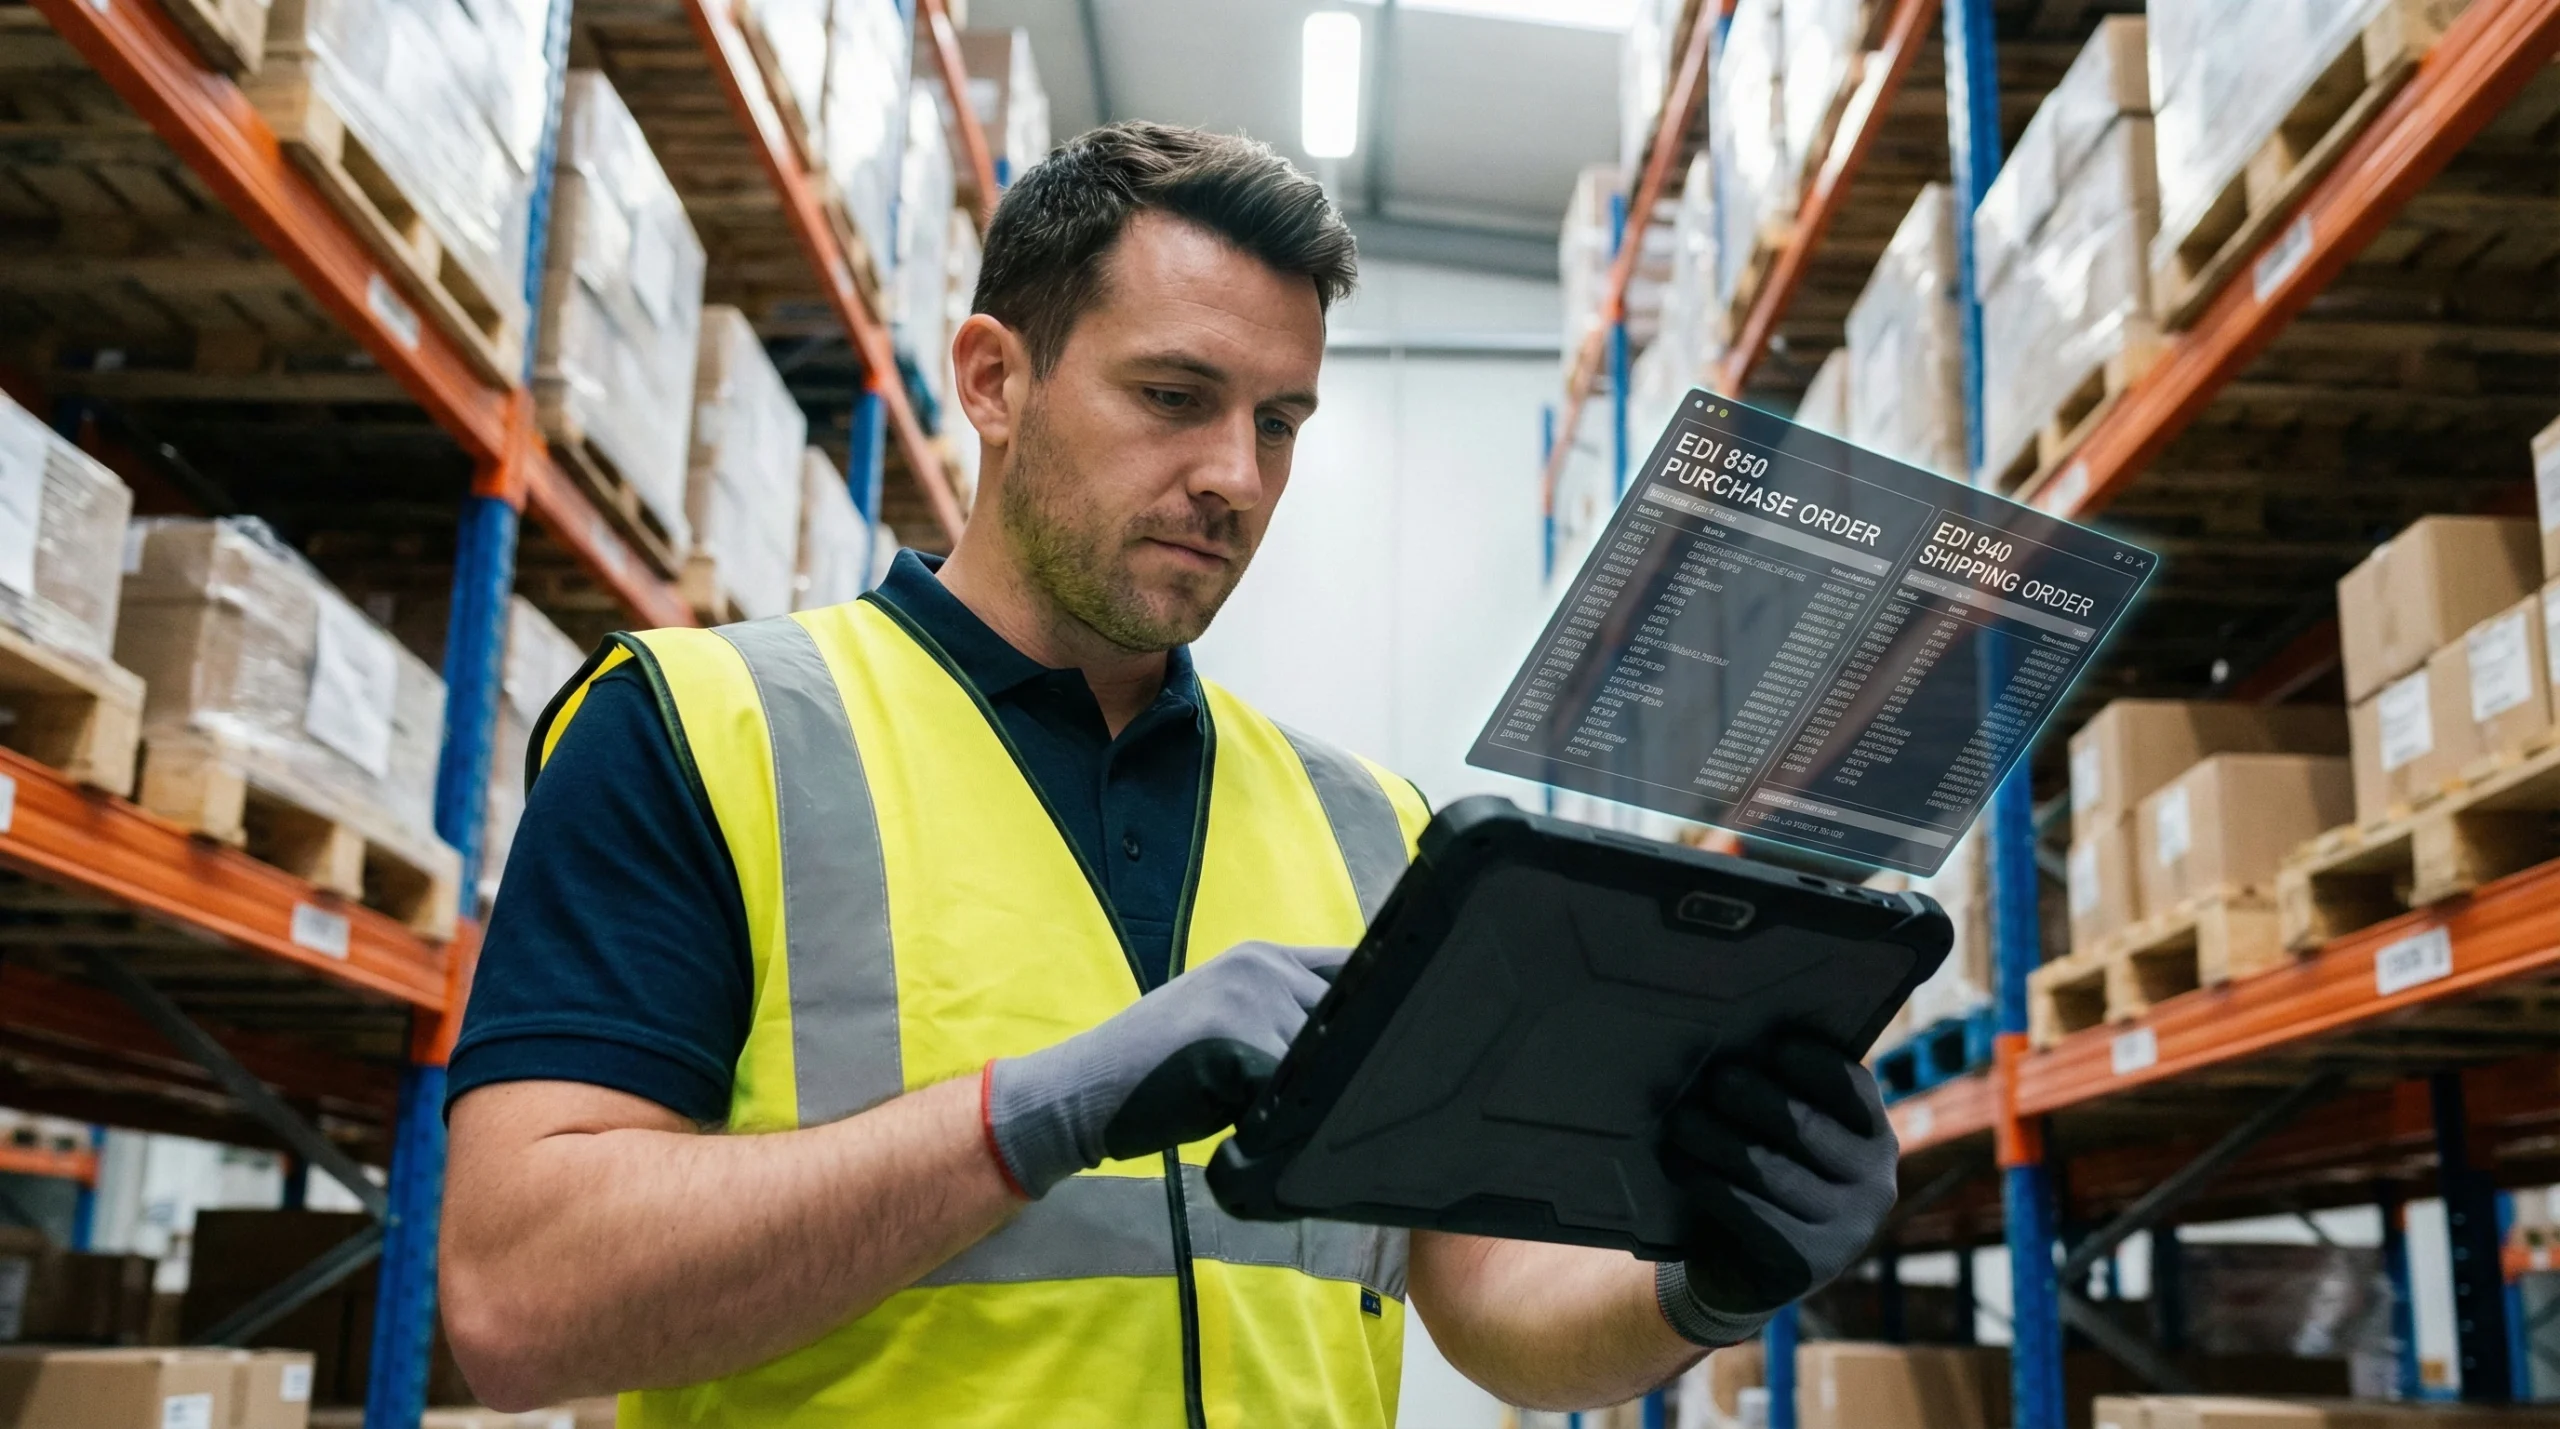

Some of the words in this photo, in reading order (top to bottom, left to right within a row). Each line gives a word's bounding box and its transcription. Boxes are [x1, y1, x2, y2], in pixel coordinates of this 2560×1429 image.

[1675, 432, 1723, 462] EDI
[1723, 449, 1769, 478] 850
[1660, 457, 1798, 517] PURCHASE
[1799, 504, 1881, 546] ORDER
[1933, 521, 1974, 550] EDI
[1973, 536, 2013, 562] 940
[1919, 545, 2021, 592] SHIPPING
[2022, 580, 2094, 616] ORDER
